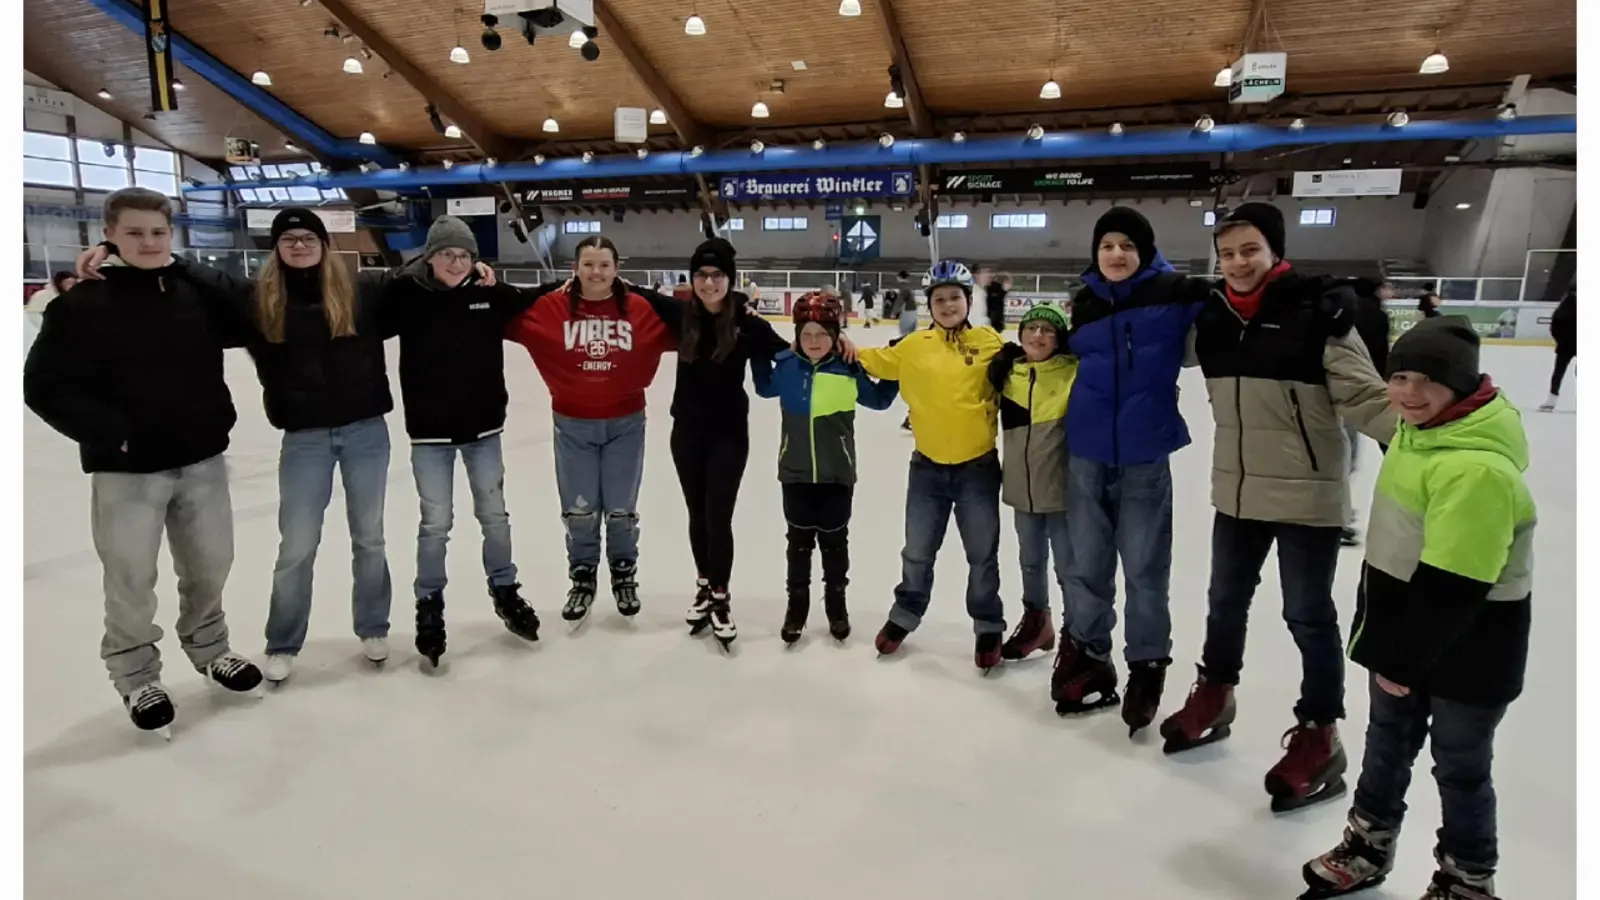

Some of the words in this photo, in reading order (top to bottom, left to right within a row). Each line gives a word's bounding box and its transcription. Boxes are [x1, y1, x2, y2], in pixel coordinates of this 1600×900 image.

[745, 178, 810, 196] Brauerei
[815, 176, 883, 193] Winkler
[967, 180, 1002, 189] SIGNAGE
[541, 189, 573, 197] WAGNER
[563, 319, 633, 351] VIBES
[590, 340, 606, 356] 26
[582, 361, 612, 371] ENERGY
